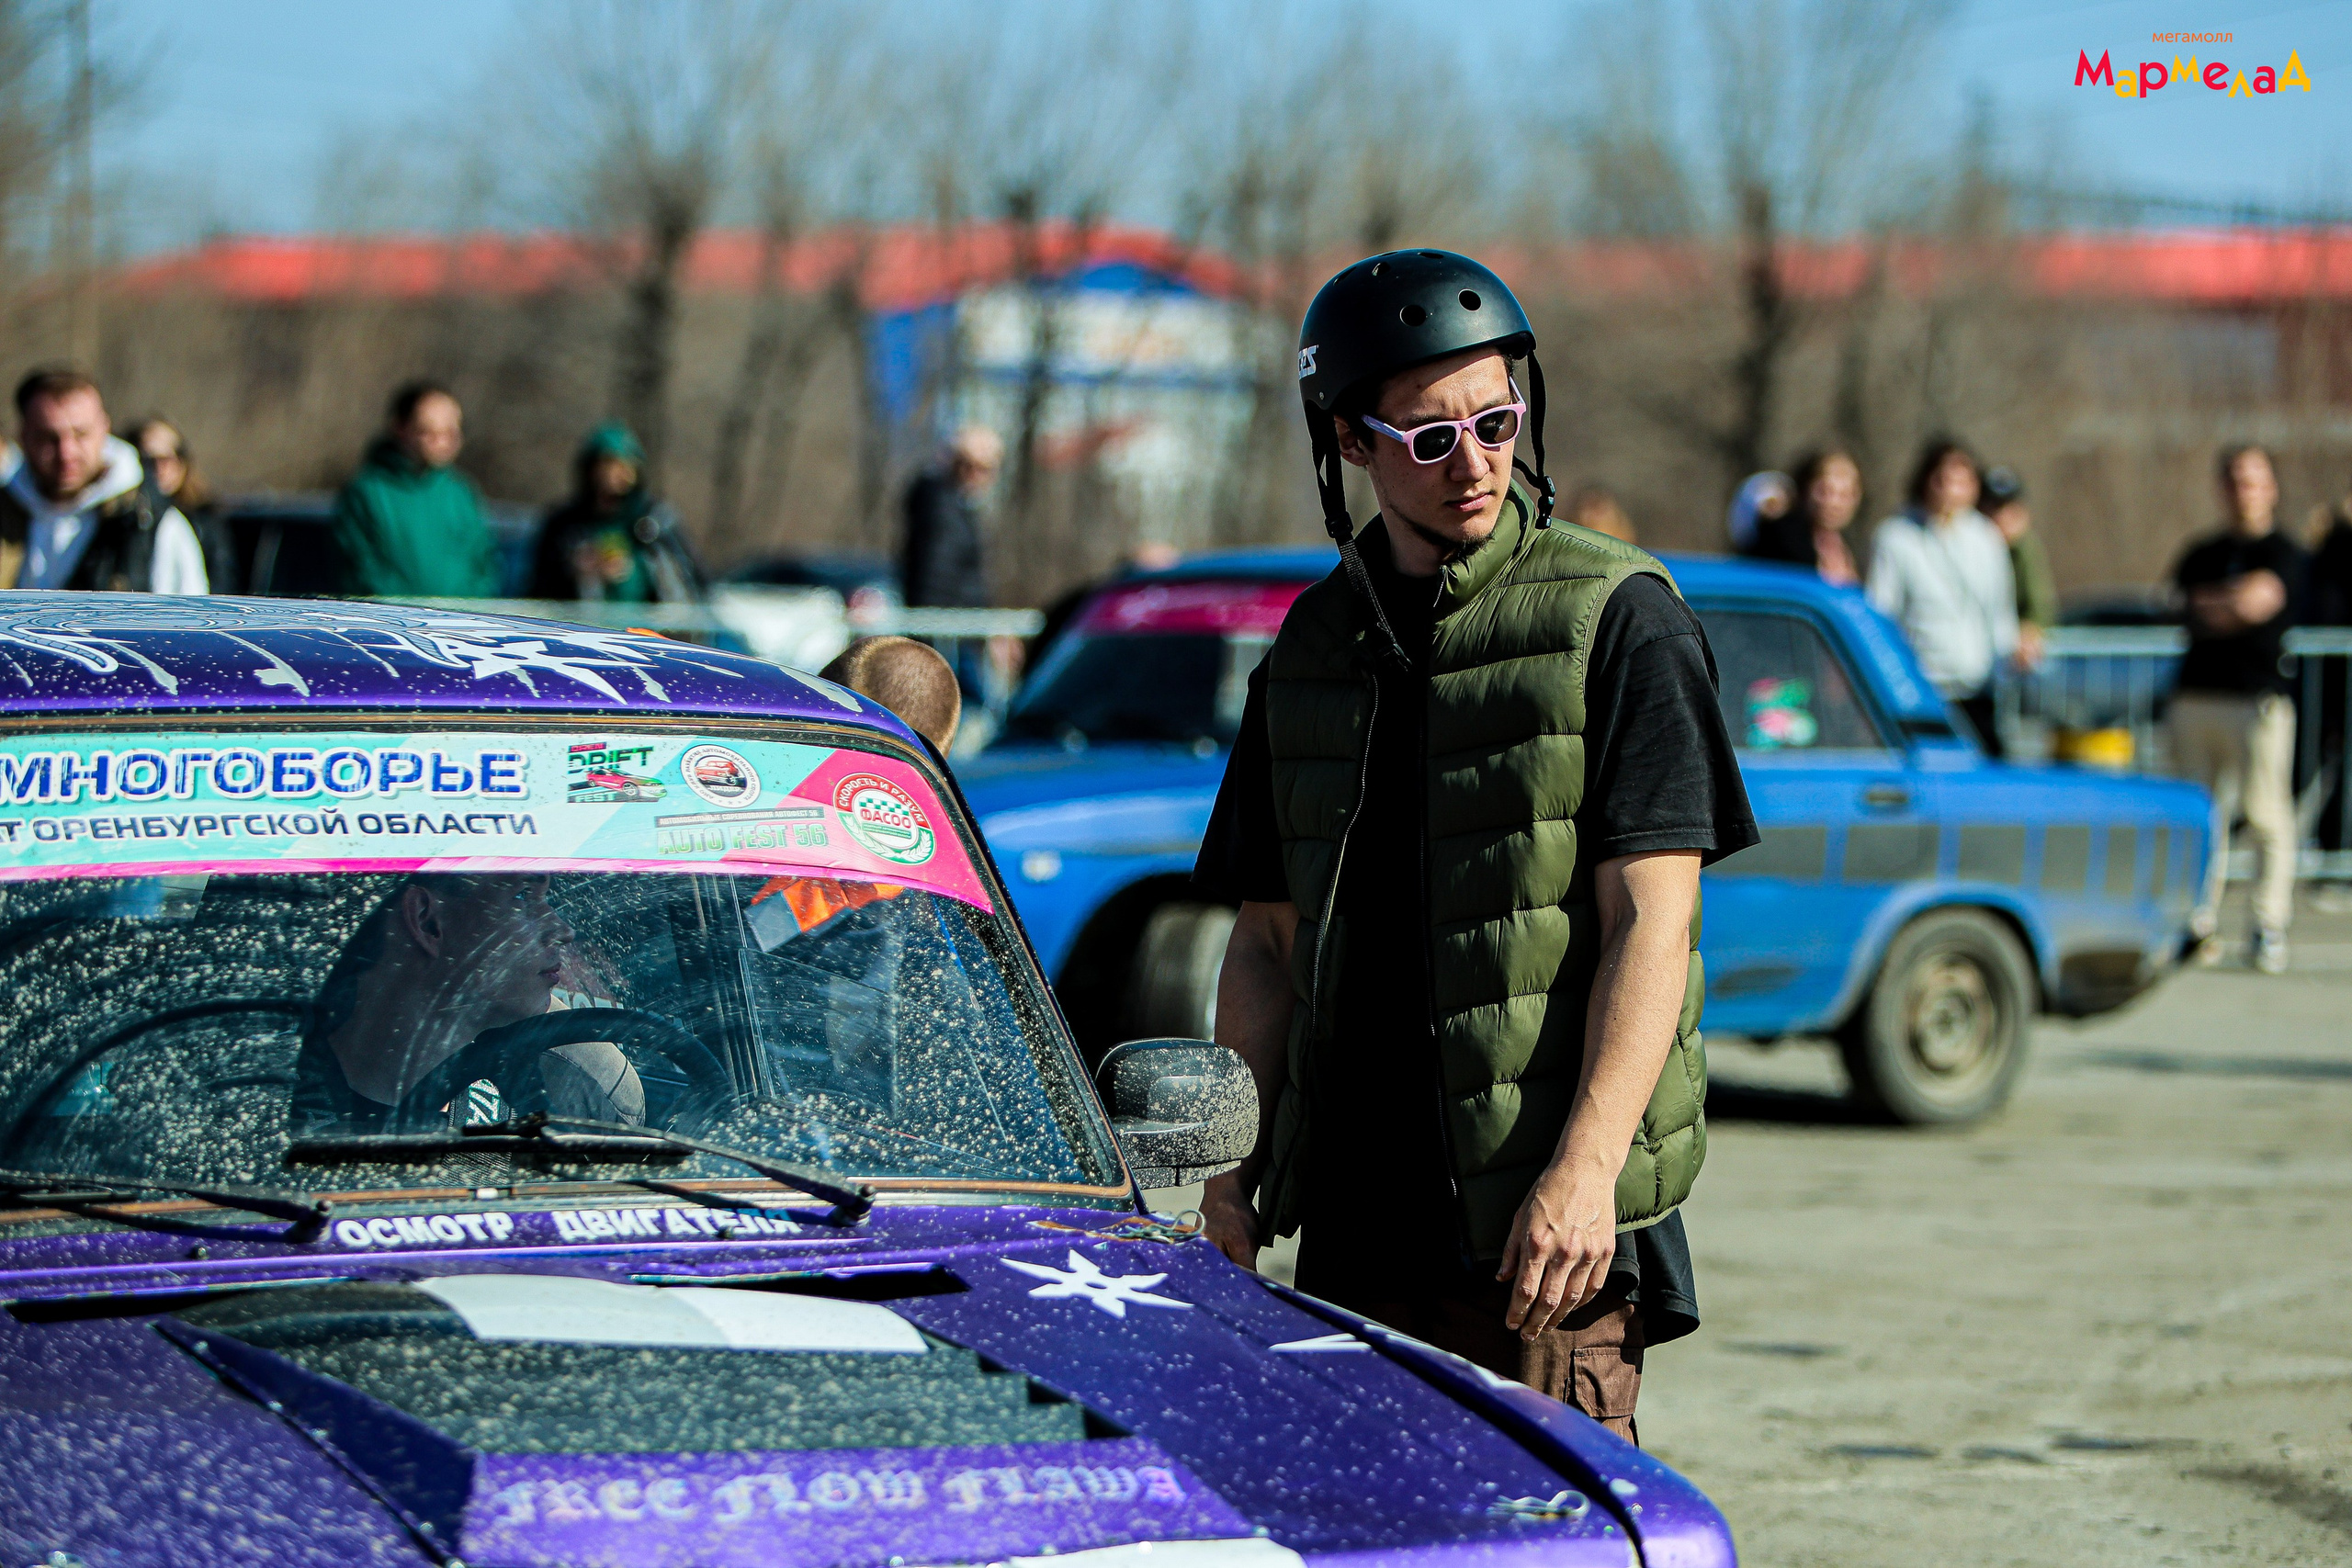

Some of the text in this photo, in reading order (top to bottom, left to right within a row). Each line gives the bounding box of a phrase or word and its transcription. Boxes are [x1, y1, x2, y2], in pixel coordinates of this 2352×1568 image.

[0, 748, 526, 802] МНОГОБОРЬЕ
[568, 746, 653, 773] DRIFT
[575, 792, 616, 803] FEST
[838, 777, 925, 823] СКОРОСТЬ И РАЗУМ
[32, 808, 349, 841] ОРЕНБУРГСКОЙ
[358, 813, 538, 836] ОБЛАСТИ
[658, 823, 828, 854] AUTO FEST 56
[336, 1208, 803, 1247] ОСМОТР ДВИГАТЕЛЯ
